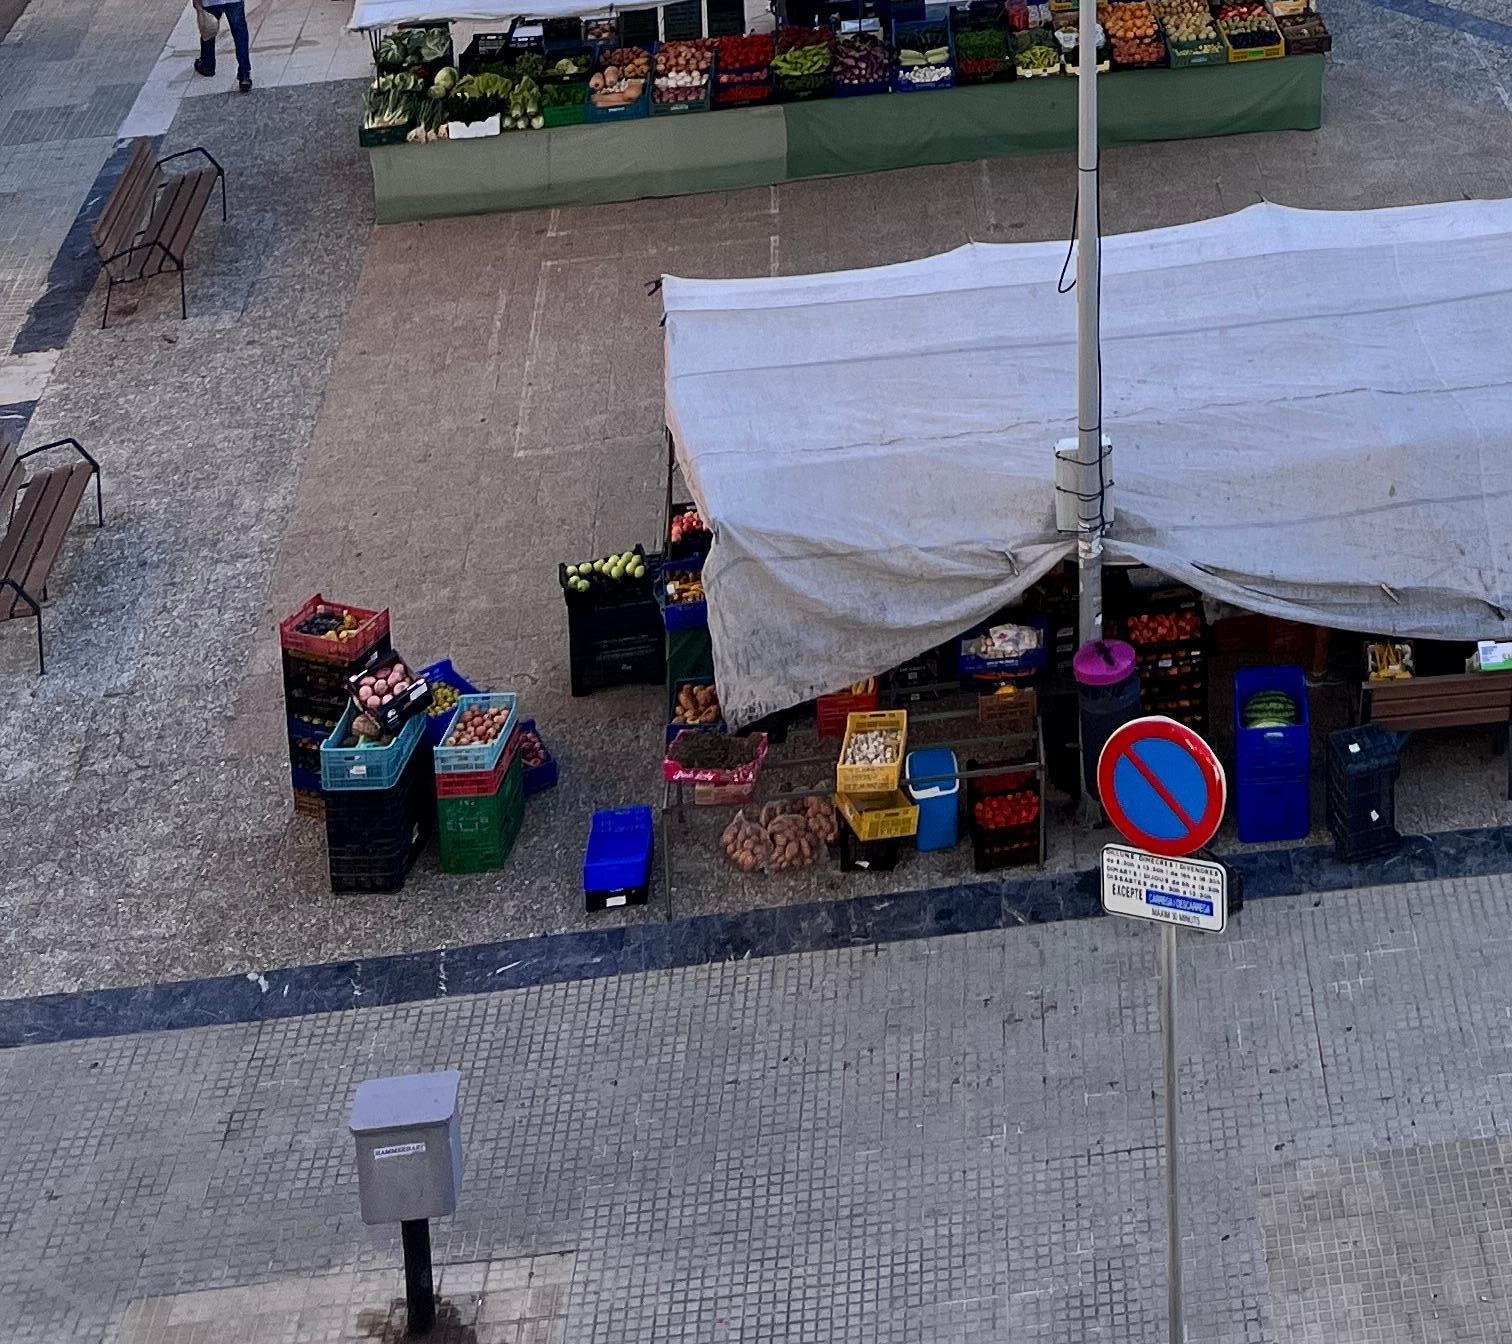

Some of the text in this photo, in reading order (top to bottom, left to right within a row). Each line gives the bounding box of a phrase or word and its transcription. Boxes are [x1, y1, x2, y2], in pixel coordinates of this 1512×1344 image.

[1106, 865, 1137, 877] DIMARTS
[1144, 873, 1169, 883] DIJOUS
[1180, 864, 1218, 877] DIVENDRES
[1106, 873, 1147, 886] DISSABTES
[1112, 883, 1143, 901] EXCEPTE
